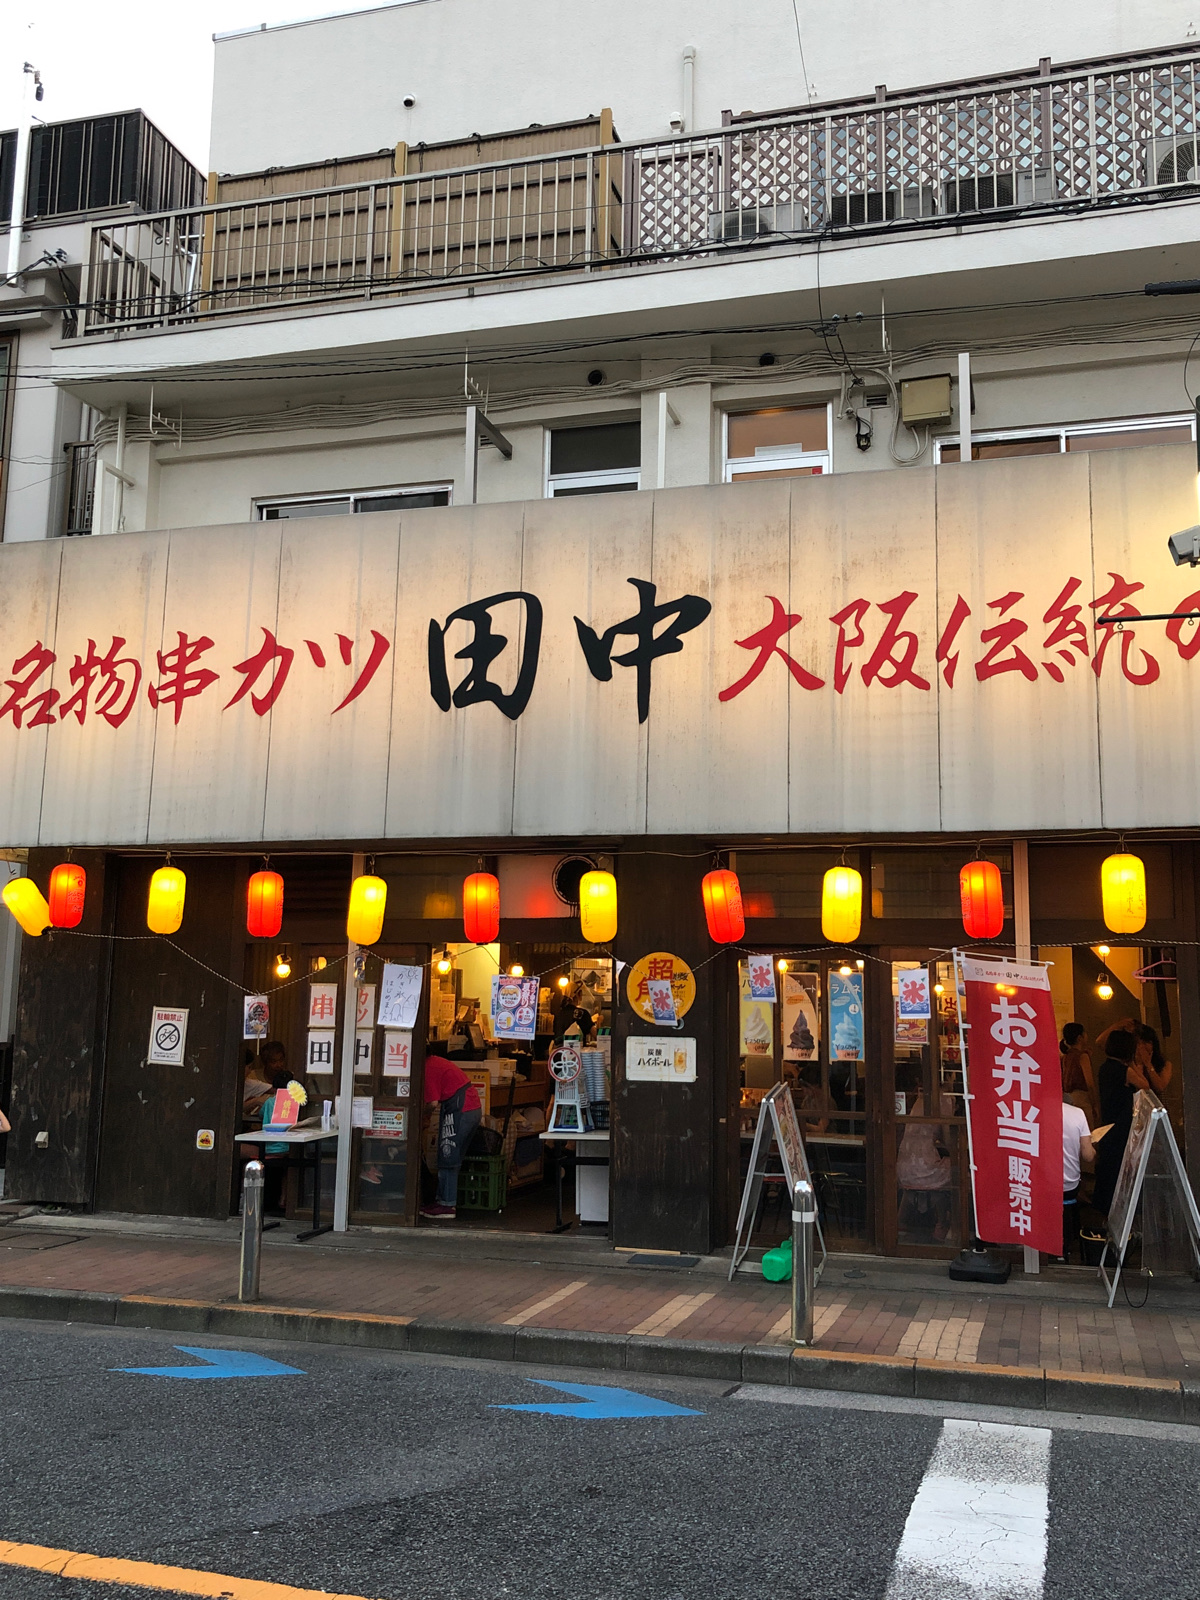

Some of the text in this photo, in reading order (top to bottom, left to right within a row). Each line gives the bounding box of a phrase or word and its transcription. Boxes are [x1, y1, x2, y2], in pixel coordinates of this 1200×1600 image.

[0, 627, 391, 730] 名物串カツ
[428, 578, 711, 723] 田中
[752, 965, 771, 988] 氷
[831, 983, 862, 994] ラムネ
[902, 980, 926, 1005] 氷
[311, 994, 334, 1020] 串
[653, 989, 671, 1012] 氷
[310, 1041, 331, 1064] 田
[387, 1044, 408, 1068] 当
[637, 1057, 672, 1067] ハイボール
[990, 997, 1041, 1236] お弁当 販売中
